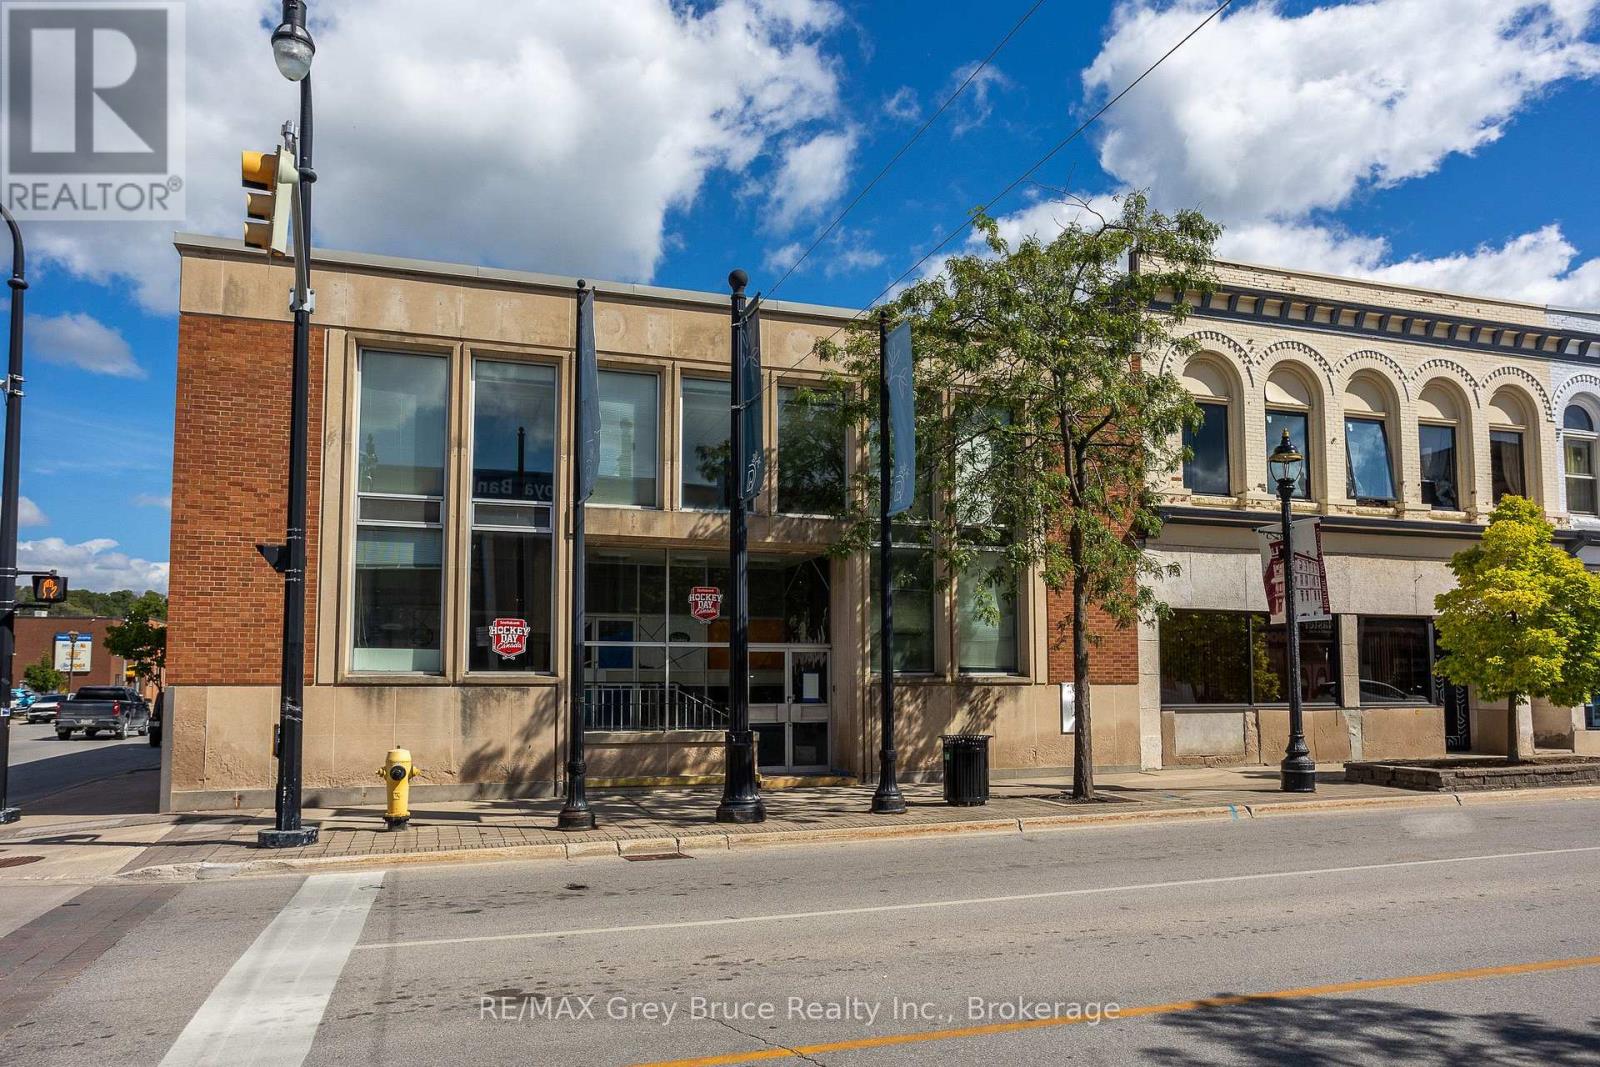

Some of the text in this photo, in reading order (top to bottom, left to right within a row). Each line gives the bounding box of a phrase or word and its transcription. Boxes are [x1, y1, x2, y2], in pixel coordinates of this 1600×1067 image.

[688, 593, 723, 602] HOCKEY
[698, 600, 713, 609] DAY
[489, 625, 530, 636] HOCKEY
[500, 634, 518, 643] DAY
[496, 641, 522, 650] Canada
